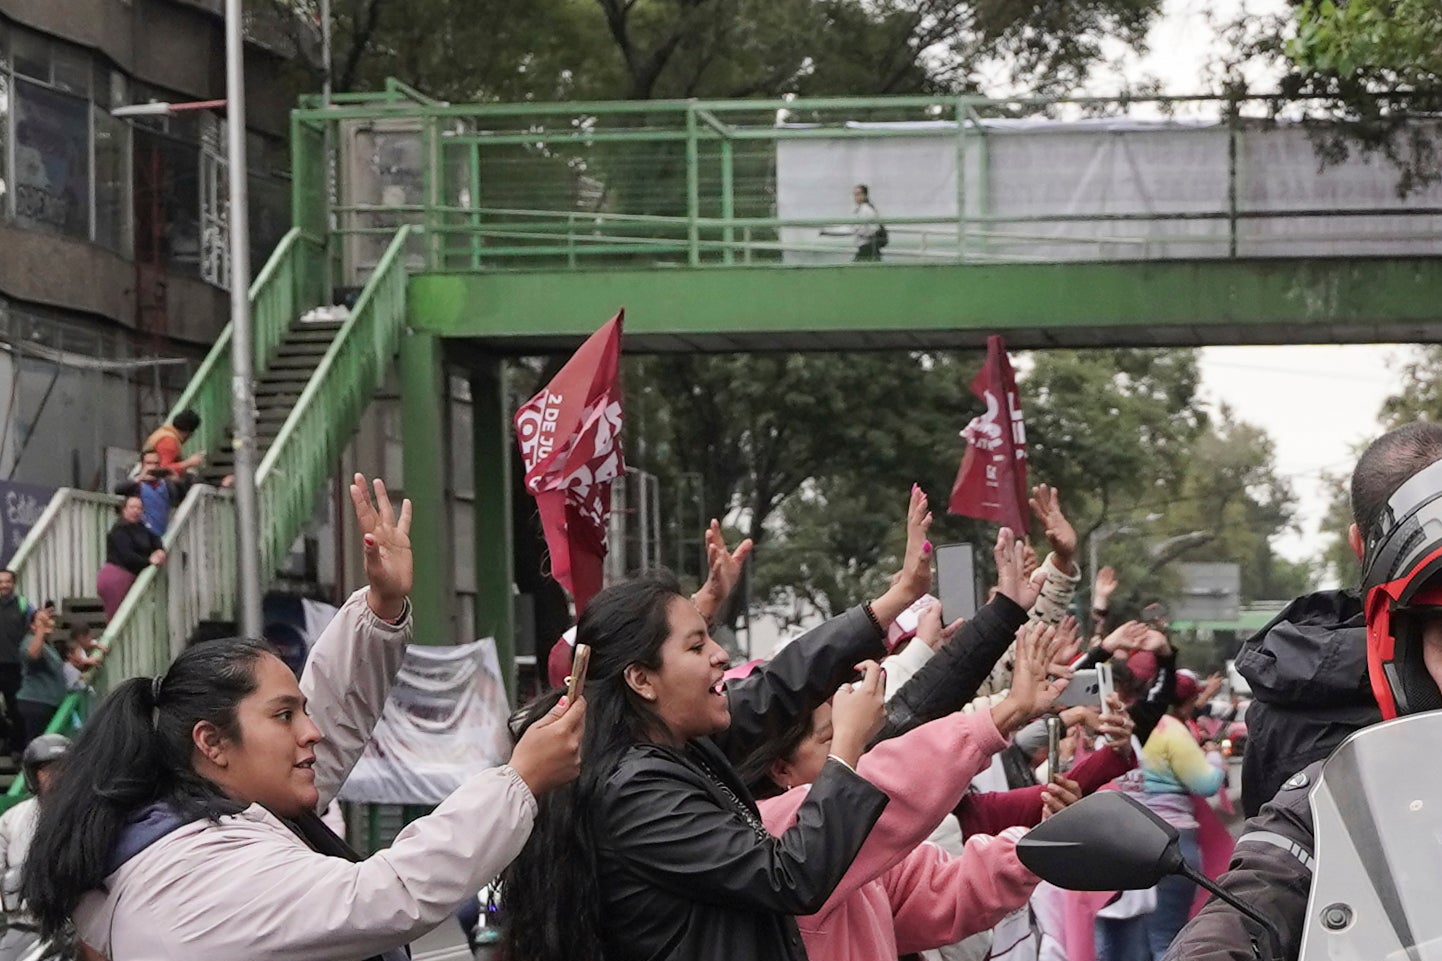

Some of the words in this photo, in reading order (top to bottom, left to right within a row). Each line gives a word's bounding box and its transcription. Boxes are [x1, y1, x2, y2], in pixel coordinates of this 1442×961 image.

[548, 394, 563, 405] 2
[541, 407, 560, 433] DE
[537, 435, 554, 463] JU
